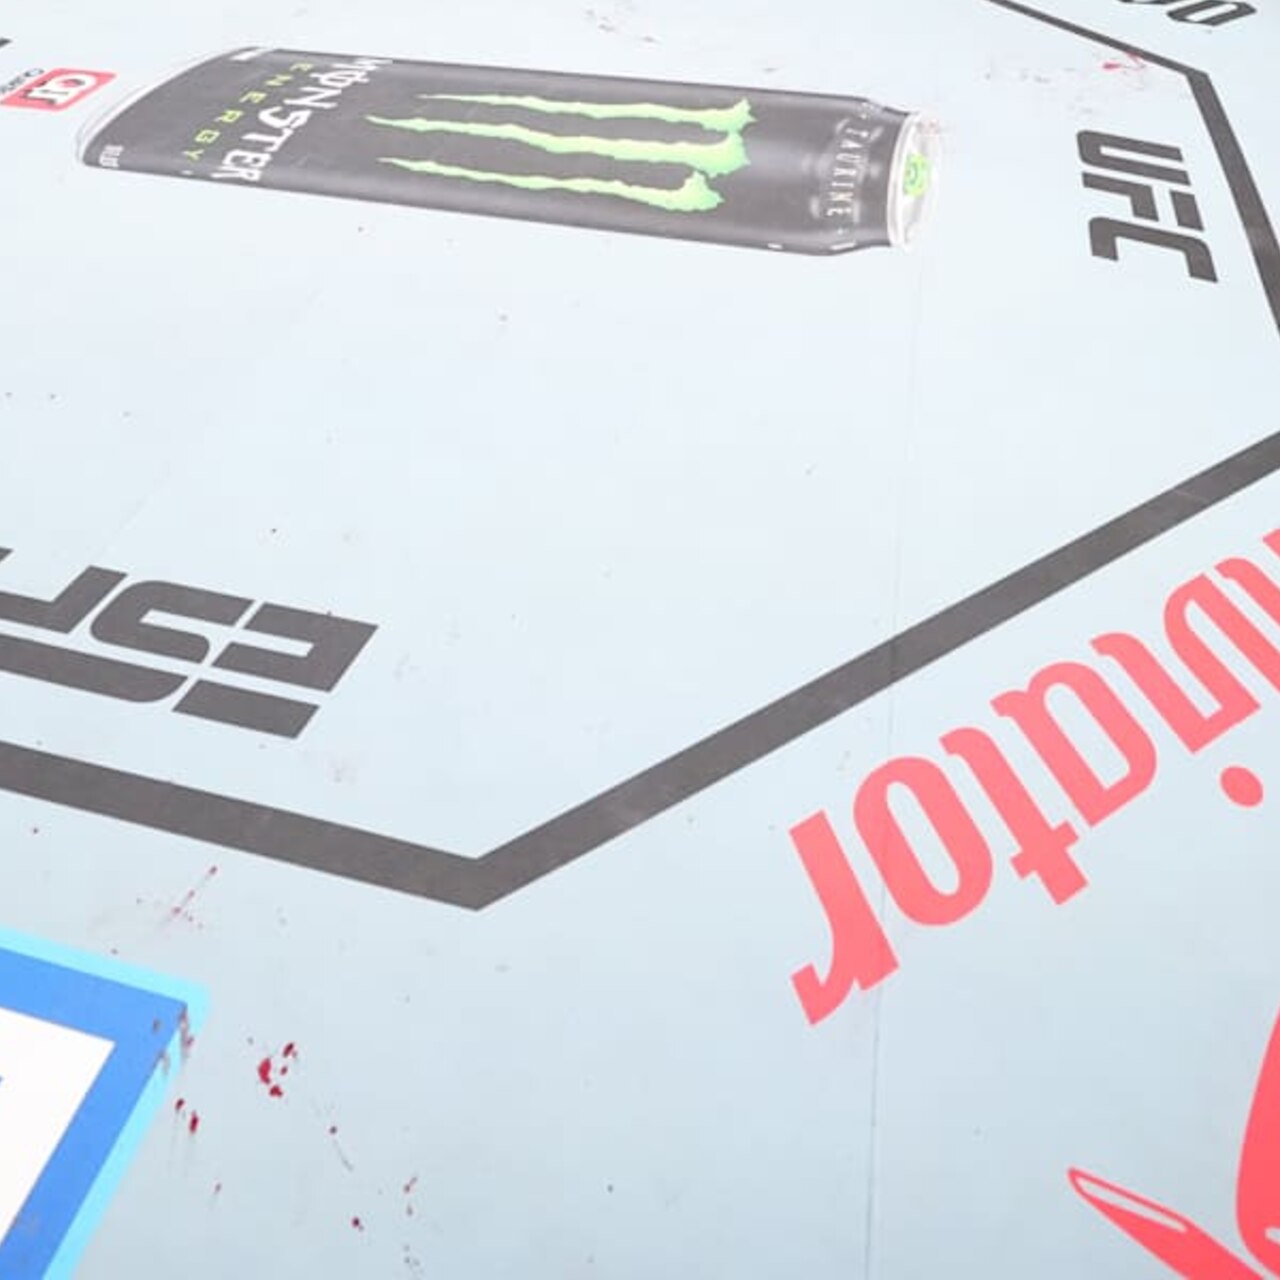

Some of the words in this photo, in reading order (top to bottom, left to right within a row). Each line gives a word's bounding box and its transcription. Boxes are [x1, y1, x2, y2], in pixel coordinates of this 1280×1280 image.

[182, 61, 316, 162] ENERGY
[210, 57, 393, 183] MONSTER
[1075, 129, 1219, 284] UFC
